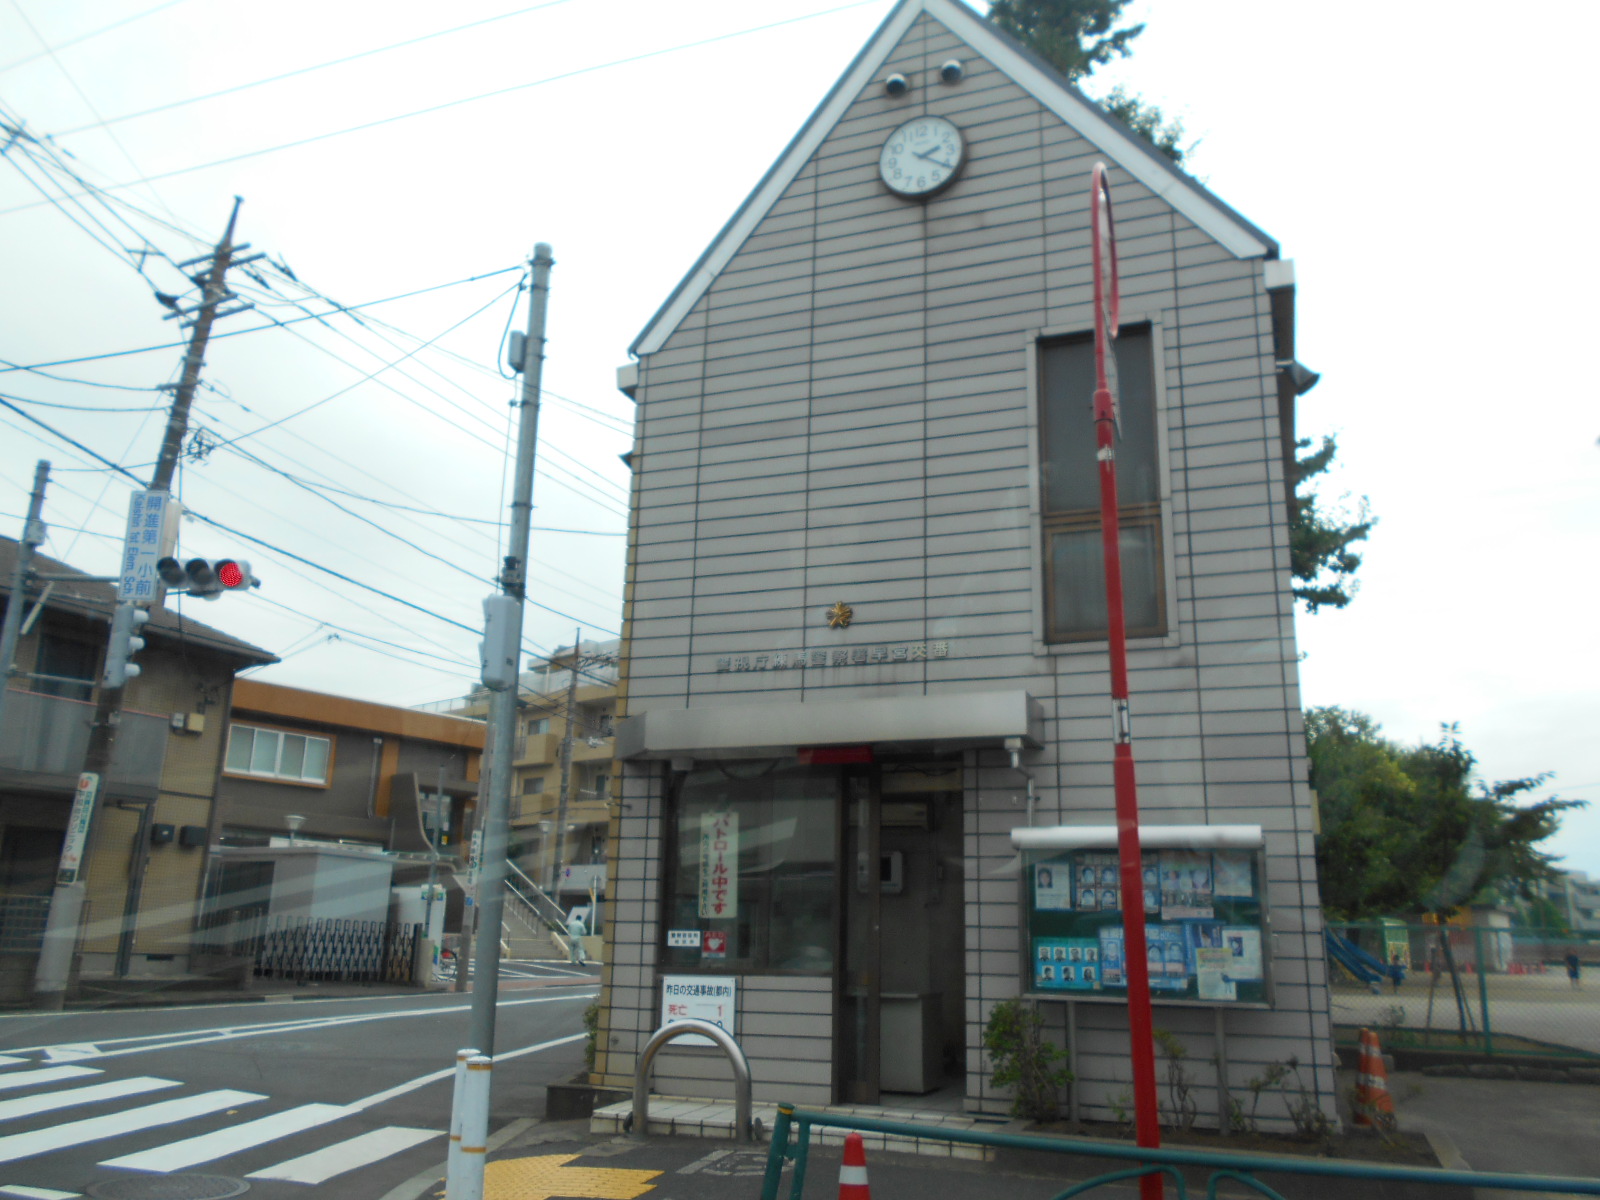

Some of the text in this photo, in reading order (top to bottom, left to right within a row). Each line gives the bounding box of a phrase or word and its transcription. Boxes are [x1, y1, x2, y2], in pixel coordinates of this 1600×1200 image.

[915, 125, 928, 137] 12
[942, 132, 951, 143] 2
[890, 143, 904, 154] 10
[945, 144, 955, 156] 3
[888, 158, 898, 169] 9
[893, 168, 902, 179] 8
[931, 170, 941, 181] 5
[905, 176, 913, 187] 7
[917, 176, 926, 187] 6
[135, 495, 162, 596] 開進第一小前
[711, 817, 729, 915] パトロール中です
[668, 1004, 688, 1016] 死亡
